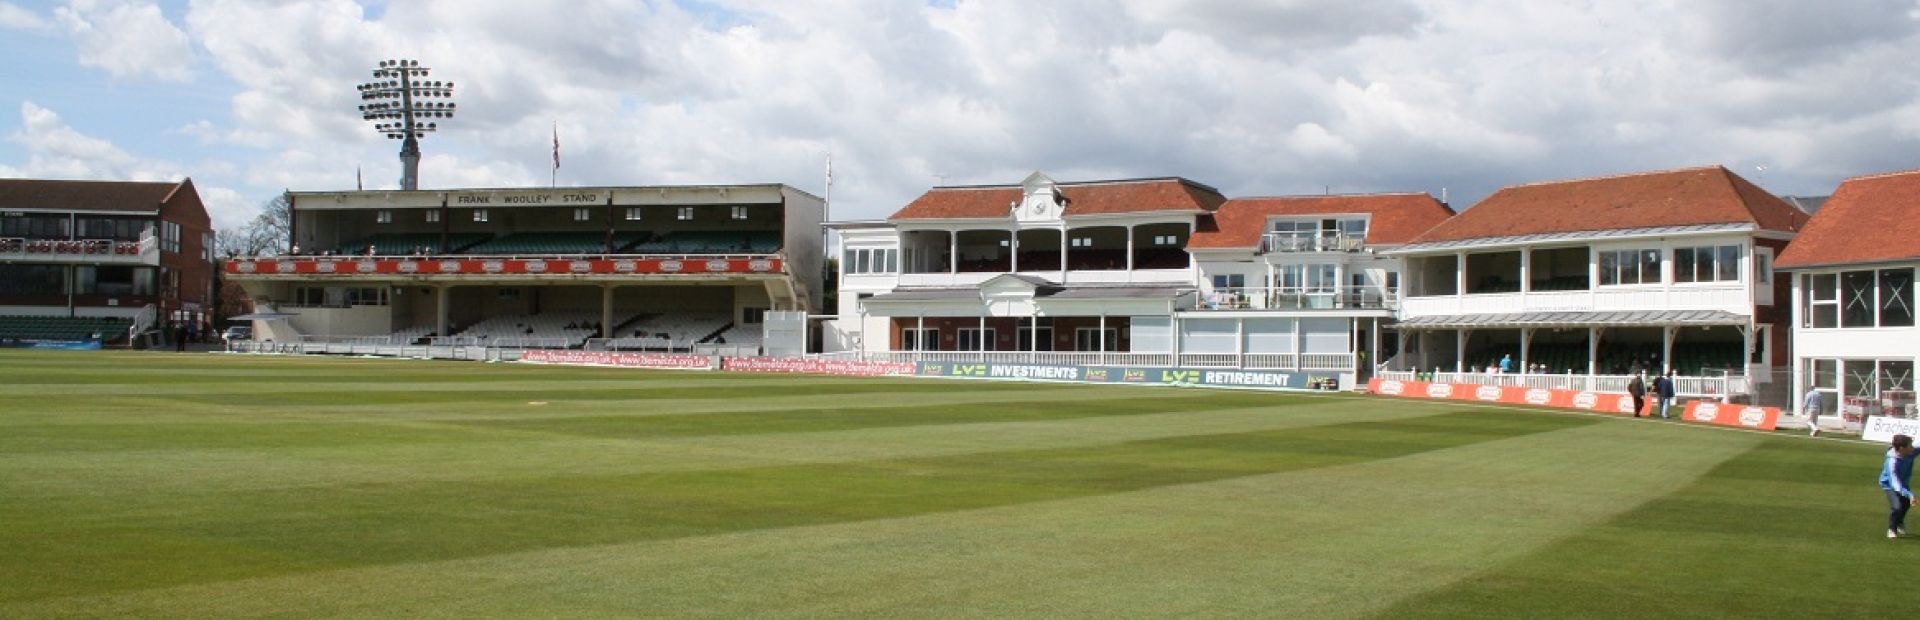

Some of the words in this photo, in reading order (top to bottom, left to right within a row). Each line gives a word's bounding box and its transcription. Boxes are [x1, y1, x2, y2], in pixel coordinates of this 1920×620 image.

[458, 195, 490, 204] FRANK
[504, 195, 548, 204] WOOLLEY
[563, 194, 597, 202] STAND
[991, 365, 1078, 379] INVESTMENTS
[1205, 370, 1290, 386] RETIREMENT
[1873, 418, 1919, 435] Brachers
